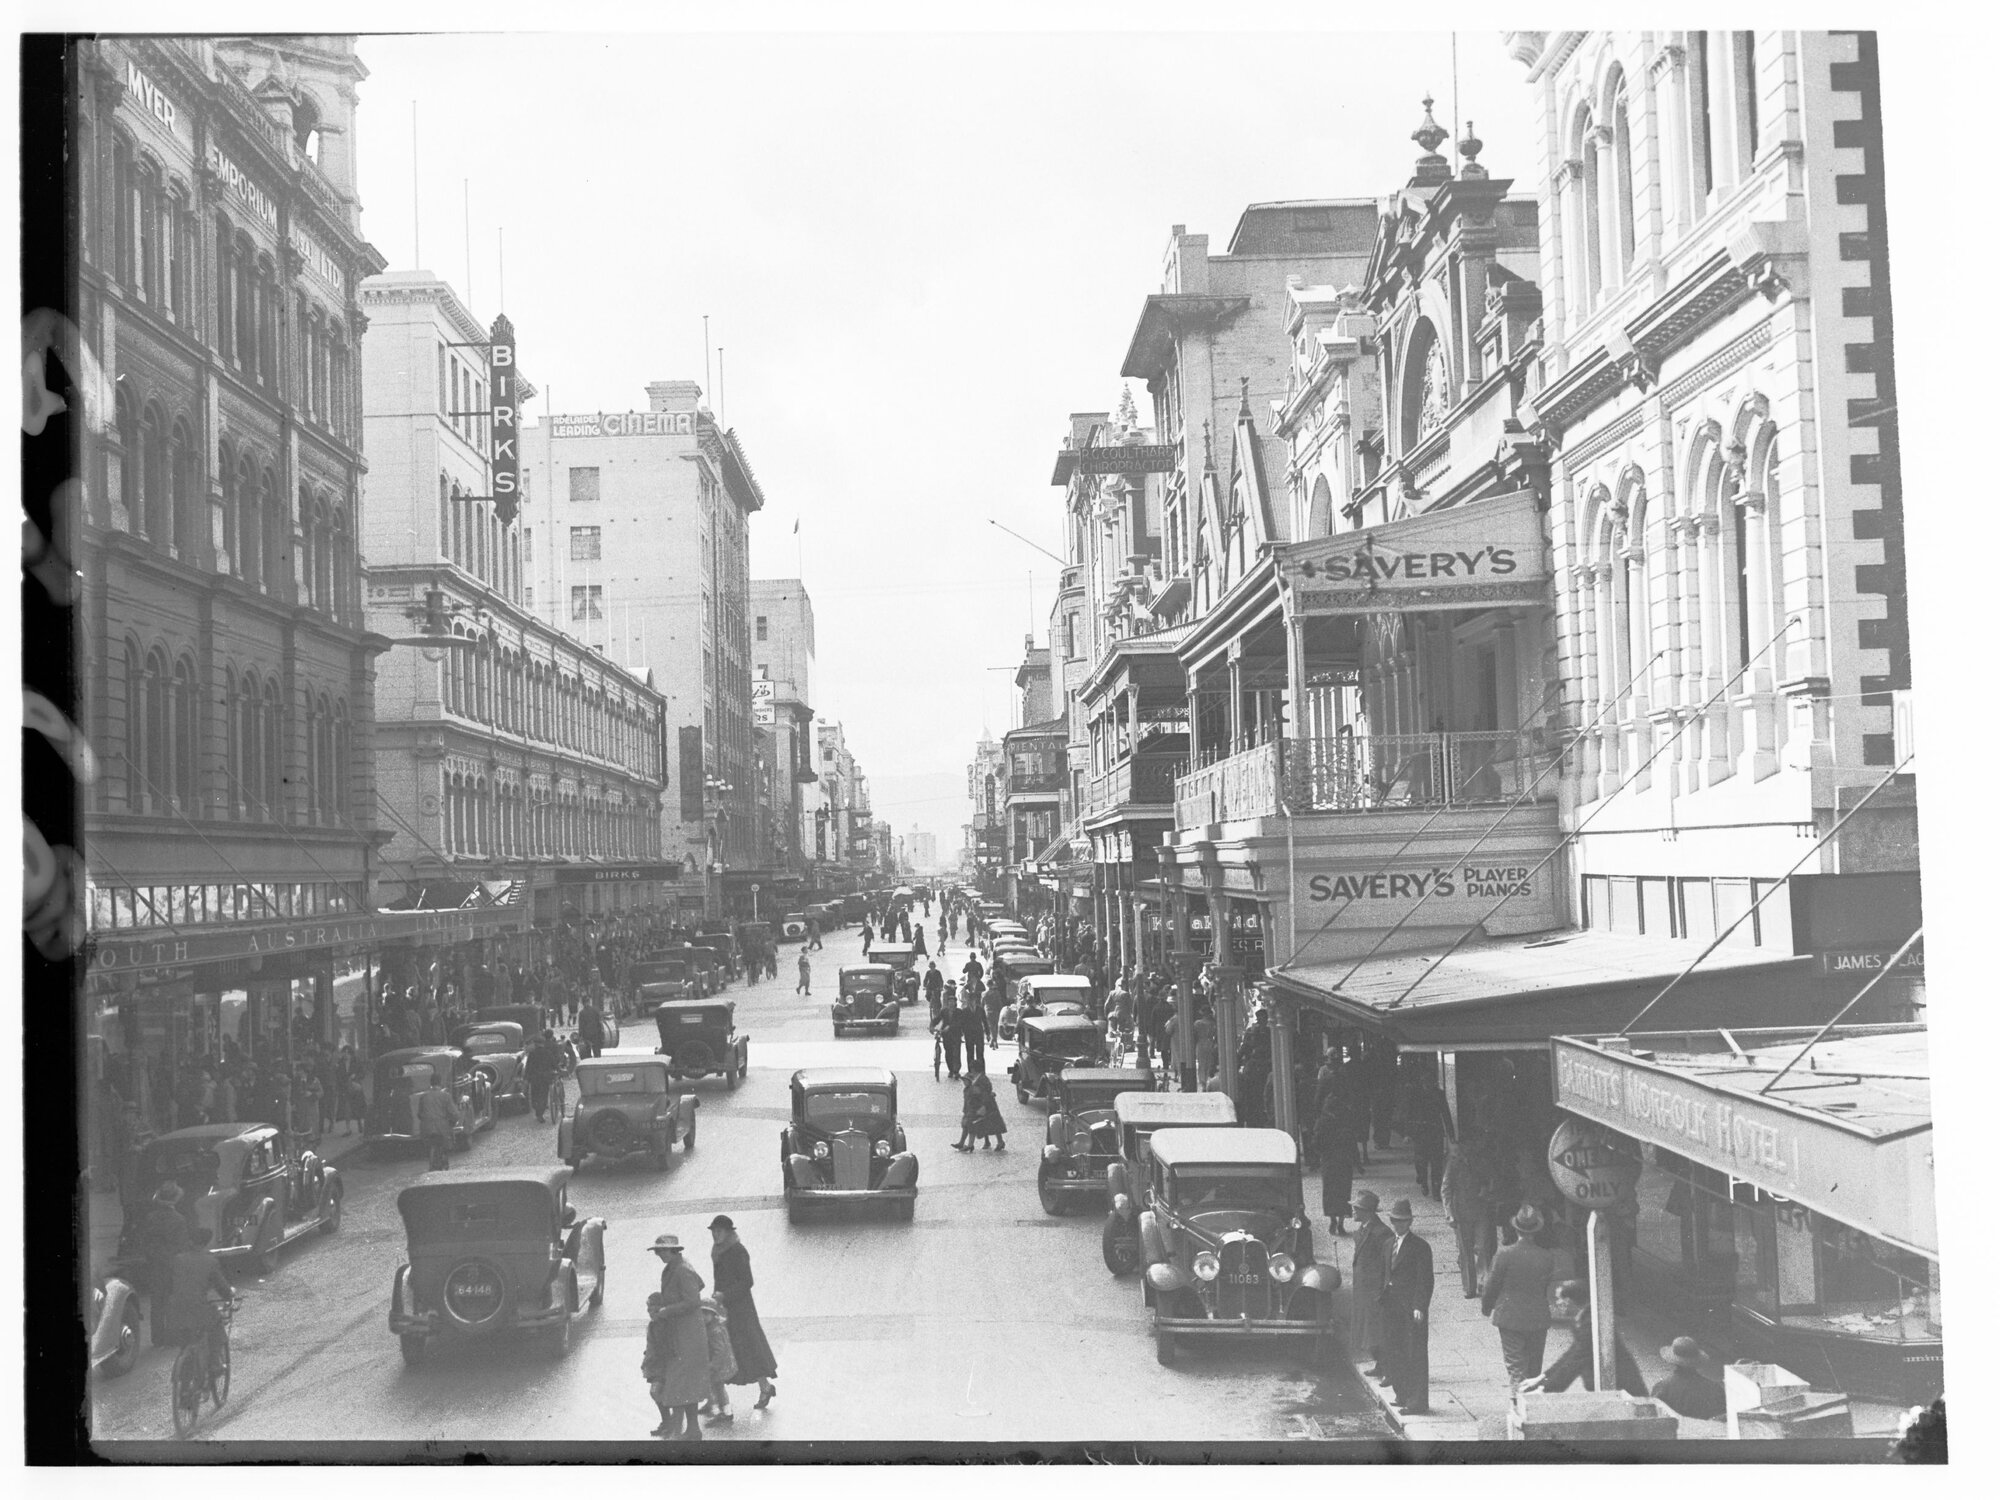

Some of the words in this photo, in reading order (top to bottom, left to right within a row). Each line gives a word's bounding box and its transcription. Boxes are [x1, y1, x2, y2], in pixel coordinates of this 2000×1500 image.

[126, 60, 177, 135] MYER
[208, 146, 278, 231] EMPORIUM
[492, 345, 516, 494] BIRKS
[552, 425, 601, 437] LEADING
[603, 413, 691, 437] CINEMA
[1081, 459, 1174, 473] CHIROPRACTOR
[1324, 544, 1518, 581] SAVERY'S
[594, 870, 641, 881] BIRKS
[1308, 867, 1456, 902] SAVERY'S
[1463, 867, 1529, 884] PLAYER
[1466, 882, 1532, 898] PIANOS
[247, 922, 378, 952] AUSTRALIA
[415, 914, 475, 932] LIMITED
[1833, 953, 1882, 970] JAMES
[1626, 1069, 1708, 1145] NORFOLK
[1575, 1182, 1621, 1199] ONLY
